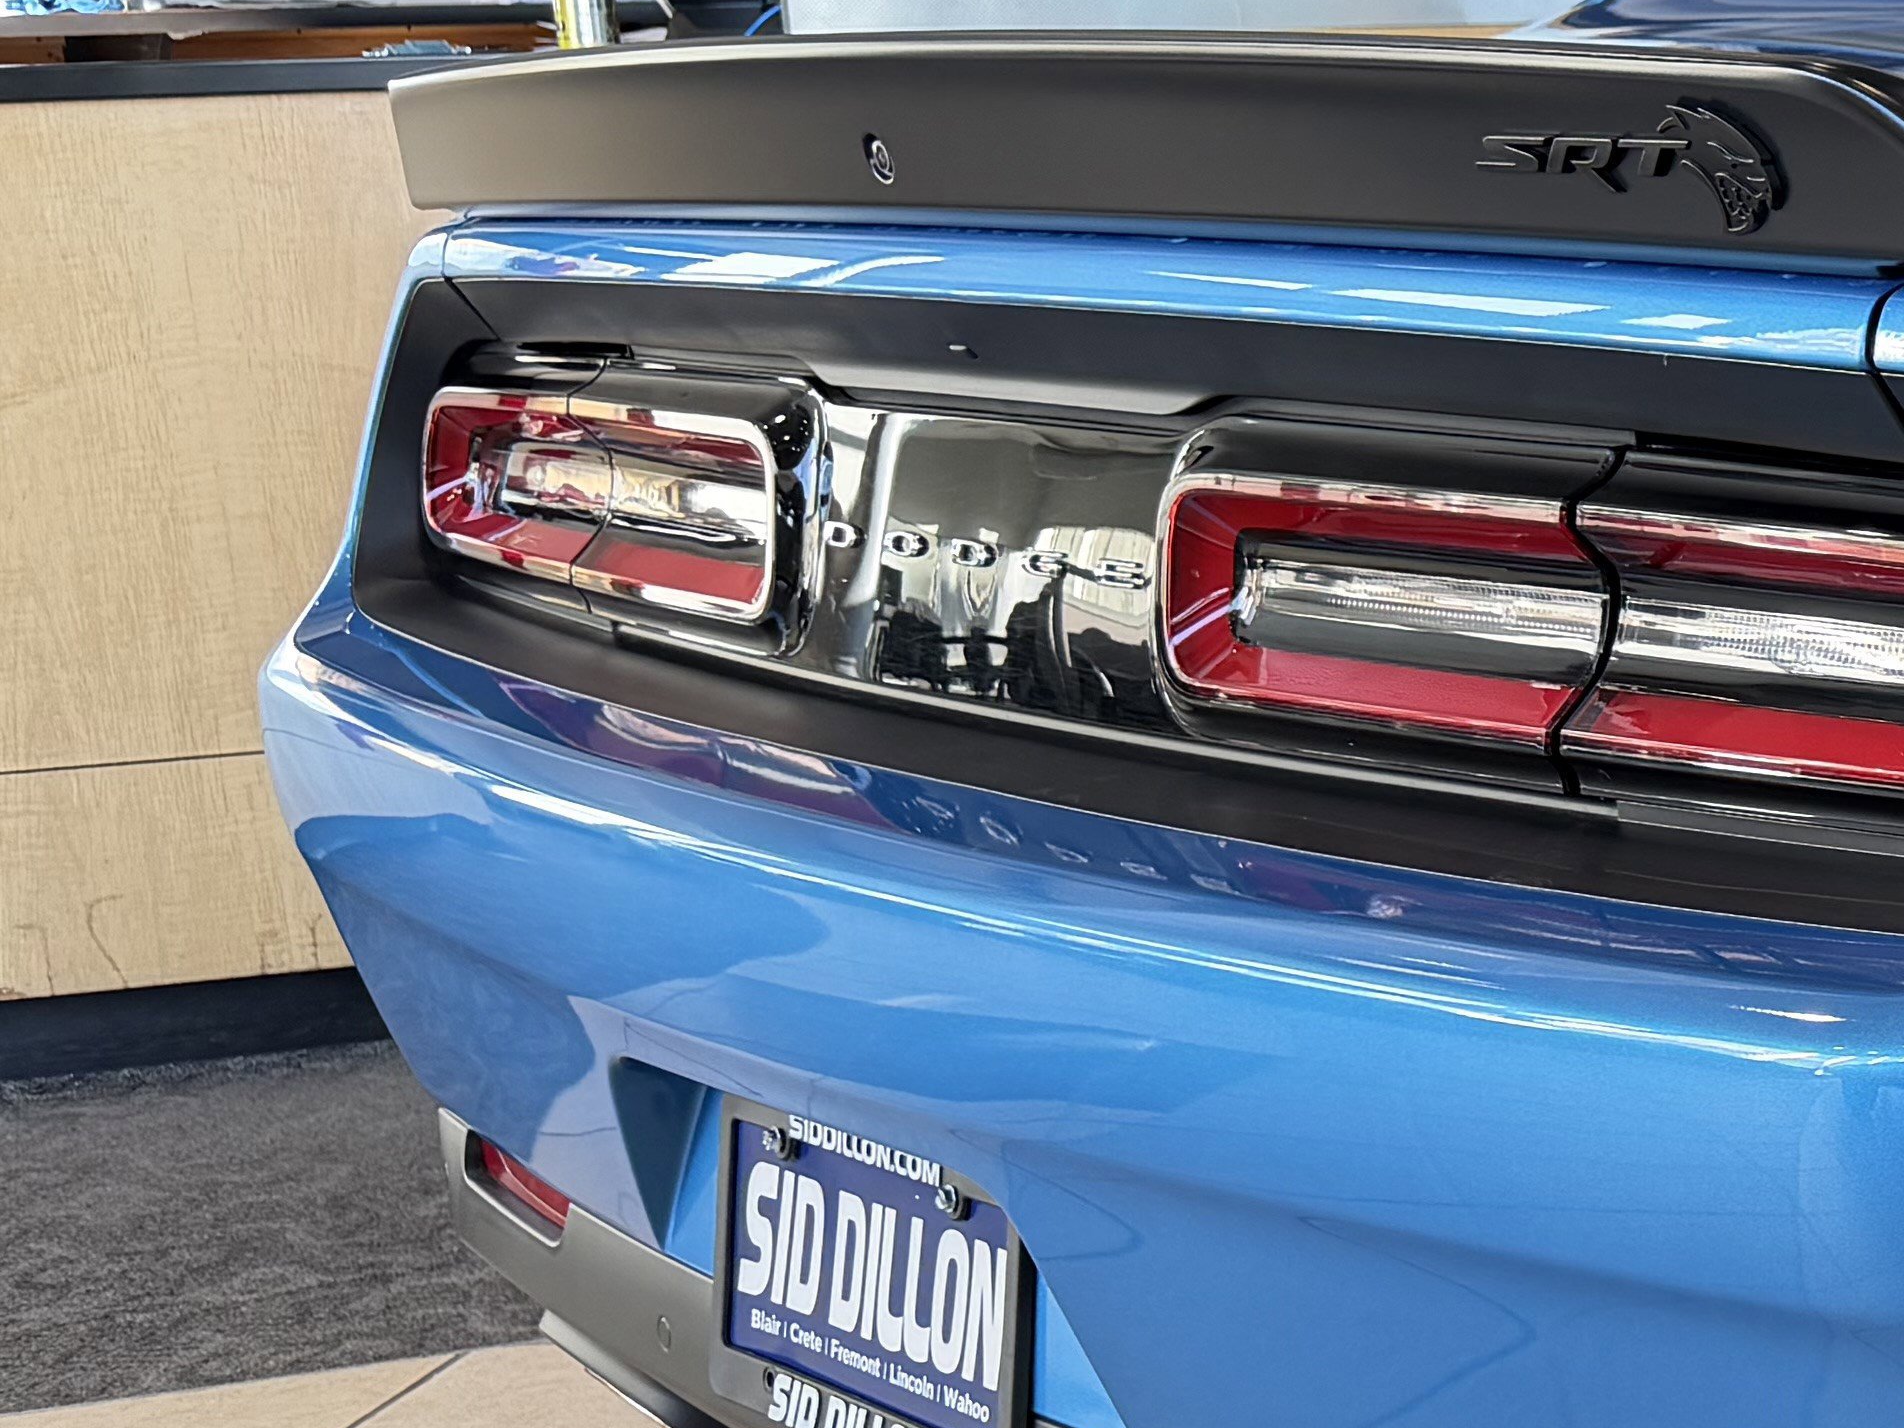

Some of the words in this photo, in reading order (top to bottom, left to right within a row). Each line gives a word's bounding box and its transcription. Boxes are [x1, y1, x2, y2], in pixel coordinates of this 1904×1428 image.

[1475, 134, 1692, 193] SRT
[822, 518, 1150, 590] DODGE
[788, 1114, 942, 1188] SIDDILLON.COM
[737, 1161, 825, 1316] SID
[828, 1190, 1008, 1392] DILLON
[750, 1308, 782, 1338] Blair
[789, 1322, 823, 1354] Crete
[829, 1337, 881, 1379] Fremont
[889, 1362, 934, 1401] Lincoln
[943, 1384, 990, 1424] Wahoo
